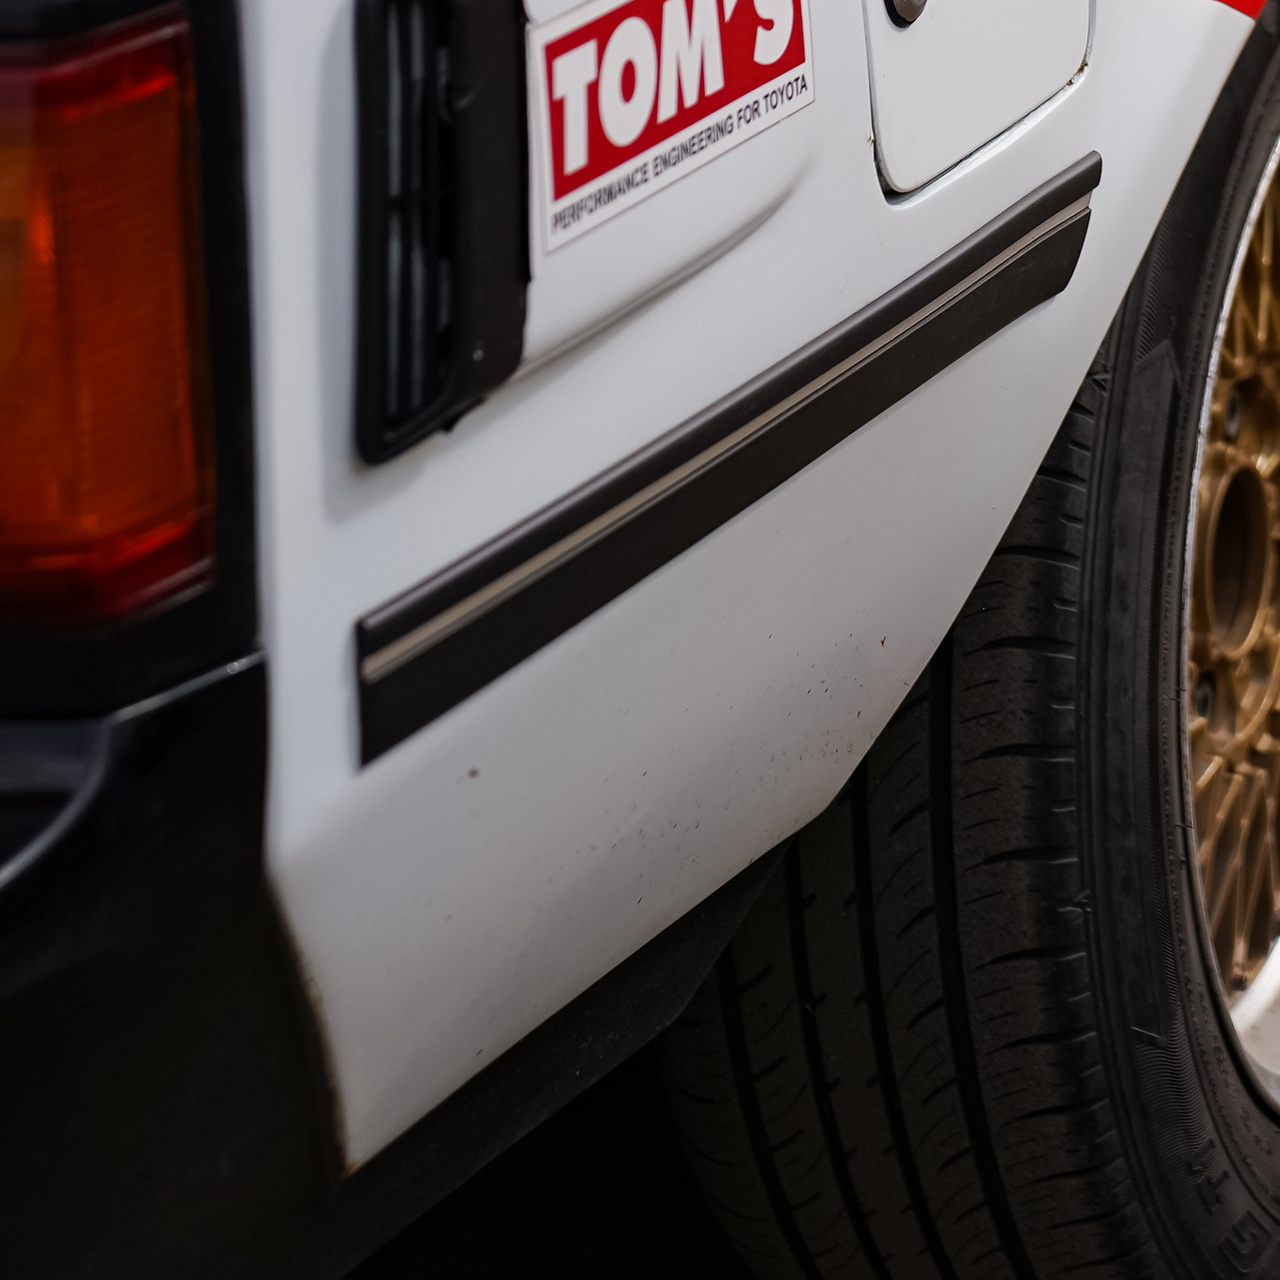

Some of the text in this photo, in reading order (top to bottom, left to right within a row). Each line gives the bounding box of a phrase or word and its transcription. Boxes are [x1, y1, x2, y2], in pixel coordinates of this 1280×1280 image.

[551, 73, 809, 234] PERFORMANCE ENGINEERING FOR TOYOTA
